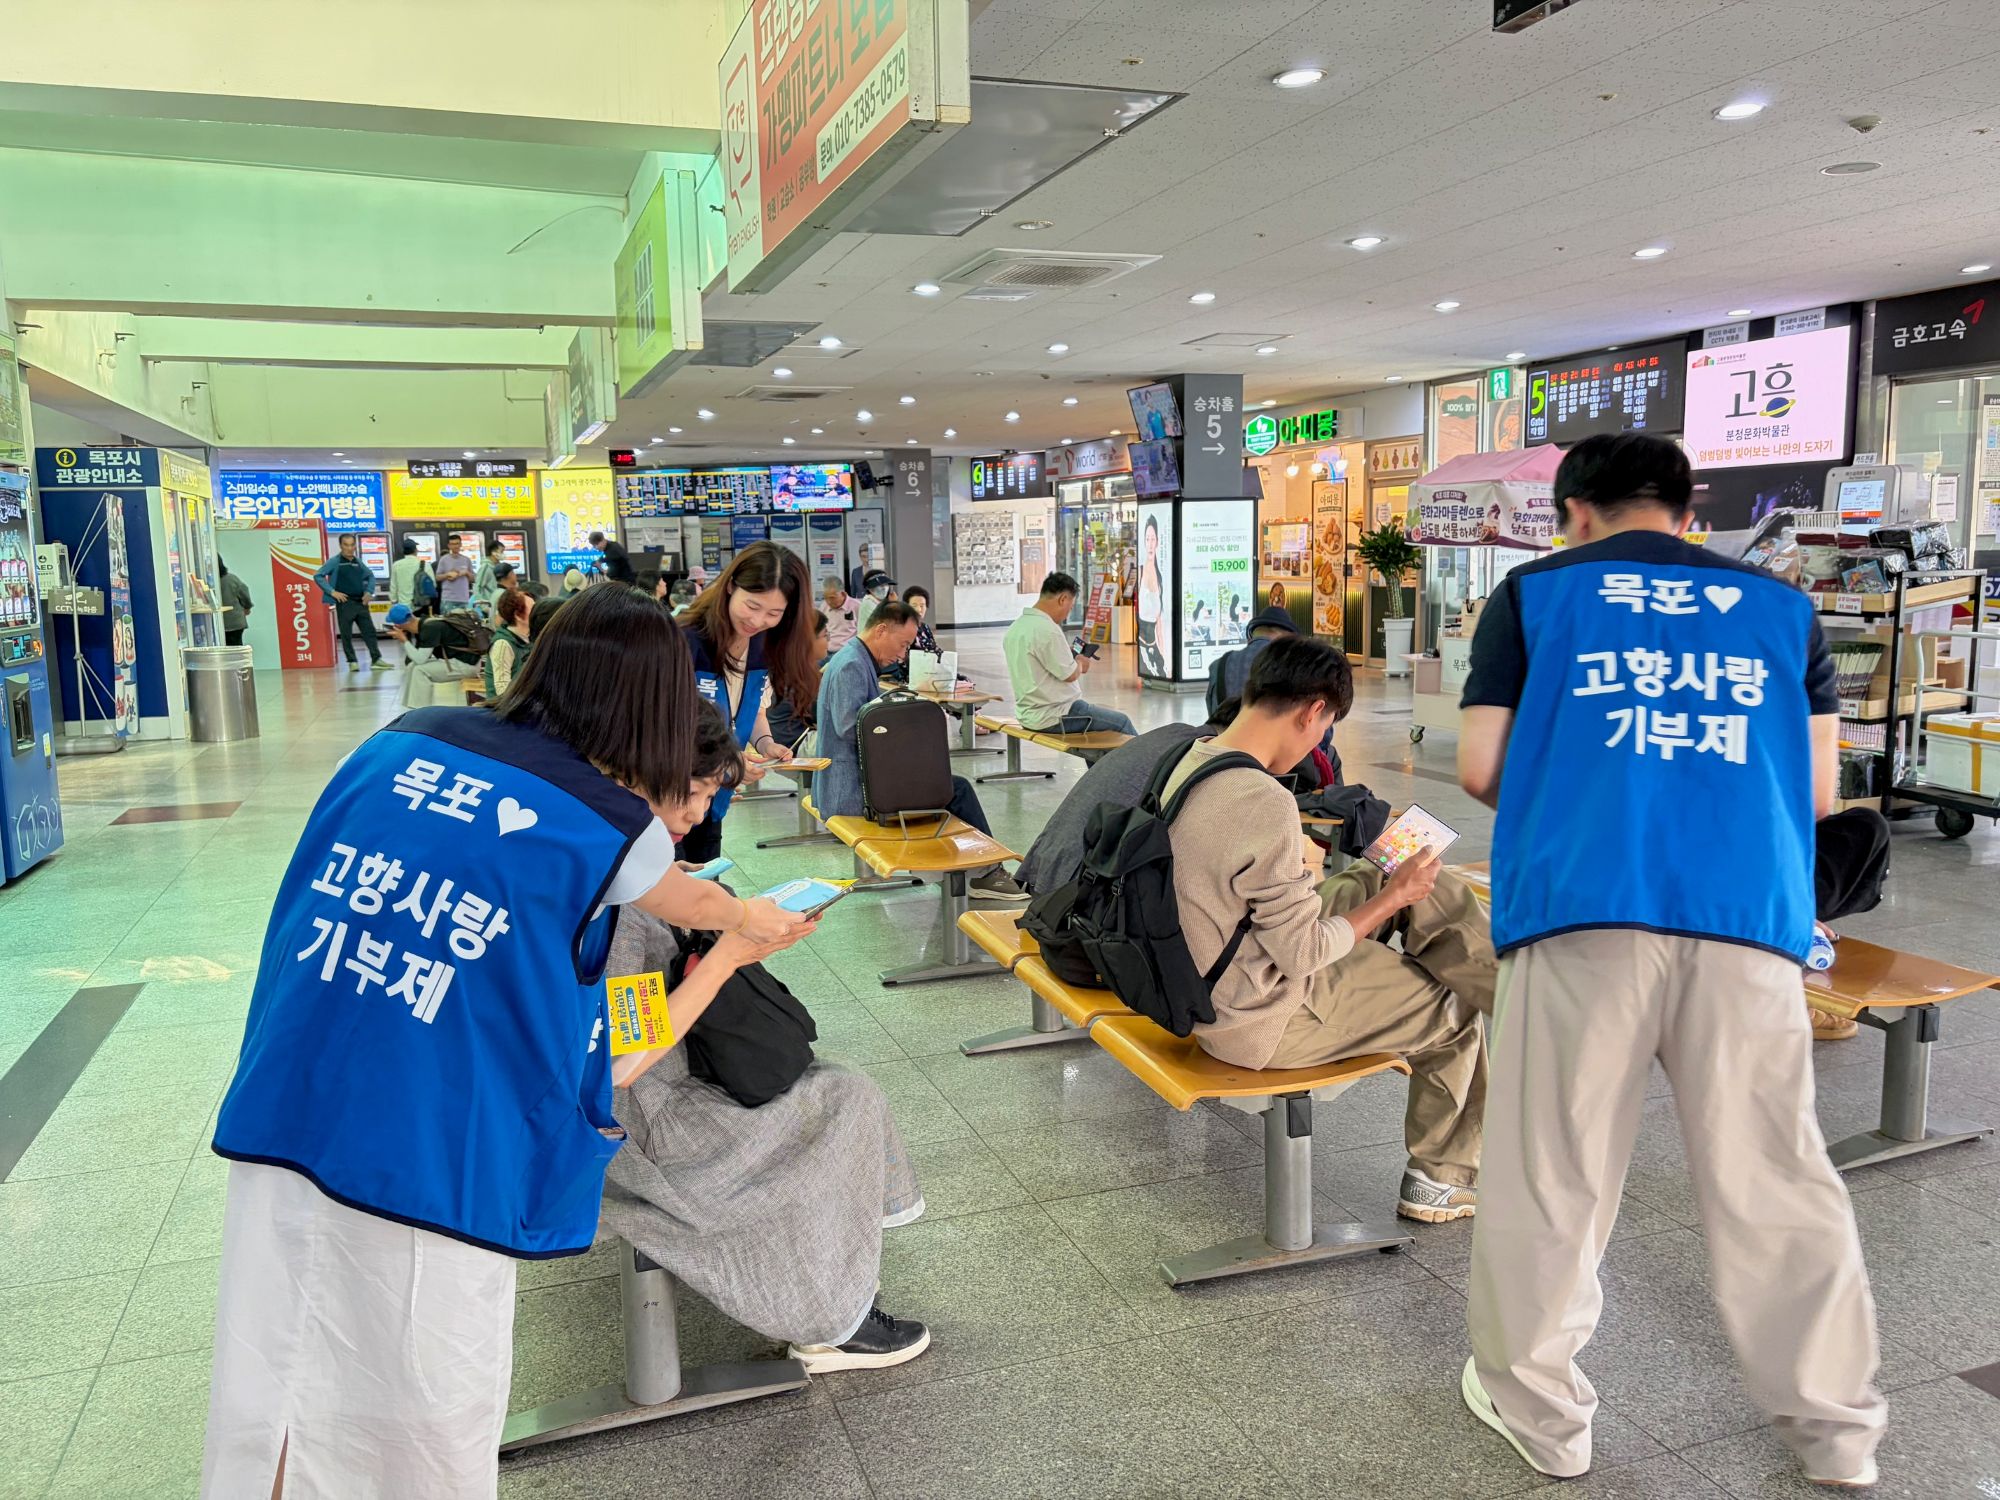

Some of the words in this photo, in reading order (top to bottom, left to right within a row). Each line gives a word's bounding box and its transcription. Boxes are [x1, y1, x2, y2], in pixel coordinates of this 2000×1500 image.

[835, 47, 906, 155] 010-7385-0579
[1710, 336, 1725, 344] CCTV
[1892, 318, 1968, 349] 금호고속
[1530, 378, 1546, 415] 5
[1725, 362, 1797, 419] 고흥
[1193, 396, 1235, 412] 승차홈
[1447, 403, 1464, 412] 100%
[1206, 415, 1222, 439] 5
[1279, 408, 1335, 444] 아피몽
[1530, 417, 1544, 427] Gate
[1725, 424, 1790, 442] 분청문화박물관
[1773, 440, 1801, 457] 나만의
[1804, 439, 1834, 454] 도자기
[88, 450, 142, 467] 목포시
[899, 461, 925, 471] 승차홈
[1075, 448, 1096, 468] world
[55, 468, 143, 484] 관광안내소
[907, 472, 919, 487] 6
[973, 463, 983, 484] 6
[226, 483, 279, 495] 스마일수술
[297, 483, 368, 495] 노안백내장수술
[461, 485, 531, 498] 국제보청기
[1420, 504, 1485, 521] 무화과마들렌으로
[280, 519, 300, 529] 365
[1420, 522, 1440, 538] 남도를
[1209, 544, 1226, 552] 60%
[1212, 559, 1246, 571] 15,900
[285, 583, 311, 593] 우체국
[1598, 573, 1701, 615] 목포
[296, 653, 313, 662] 코너
[1572, 647, 1770, 707] 고향사랑
[1603, 705, 1749, 765] 기부제
[392, 757, 495, 824] 목포
[310, 841, 511, 961] 고향사랑
[297, 916, 456, 1025] 기부제
[649, 977, 659, 997] 목포
[637, 979, 652, 1016] 고향사랑
[643, 1017, 657, 1045] 기부제
